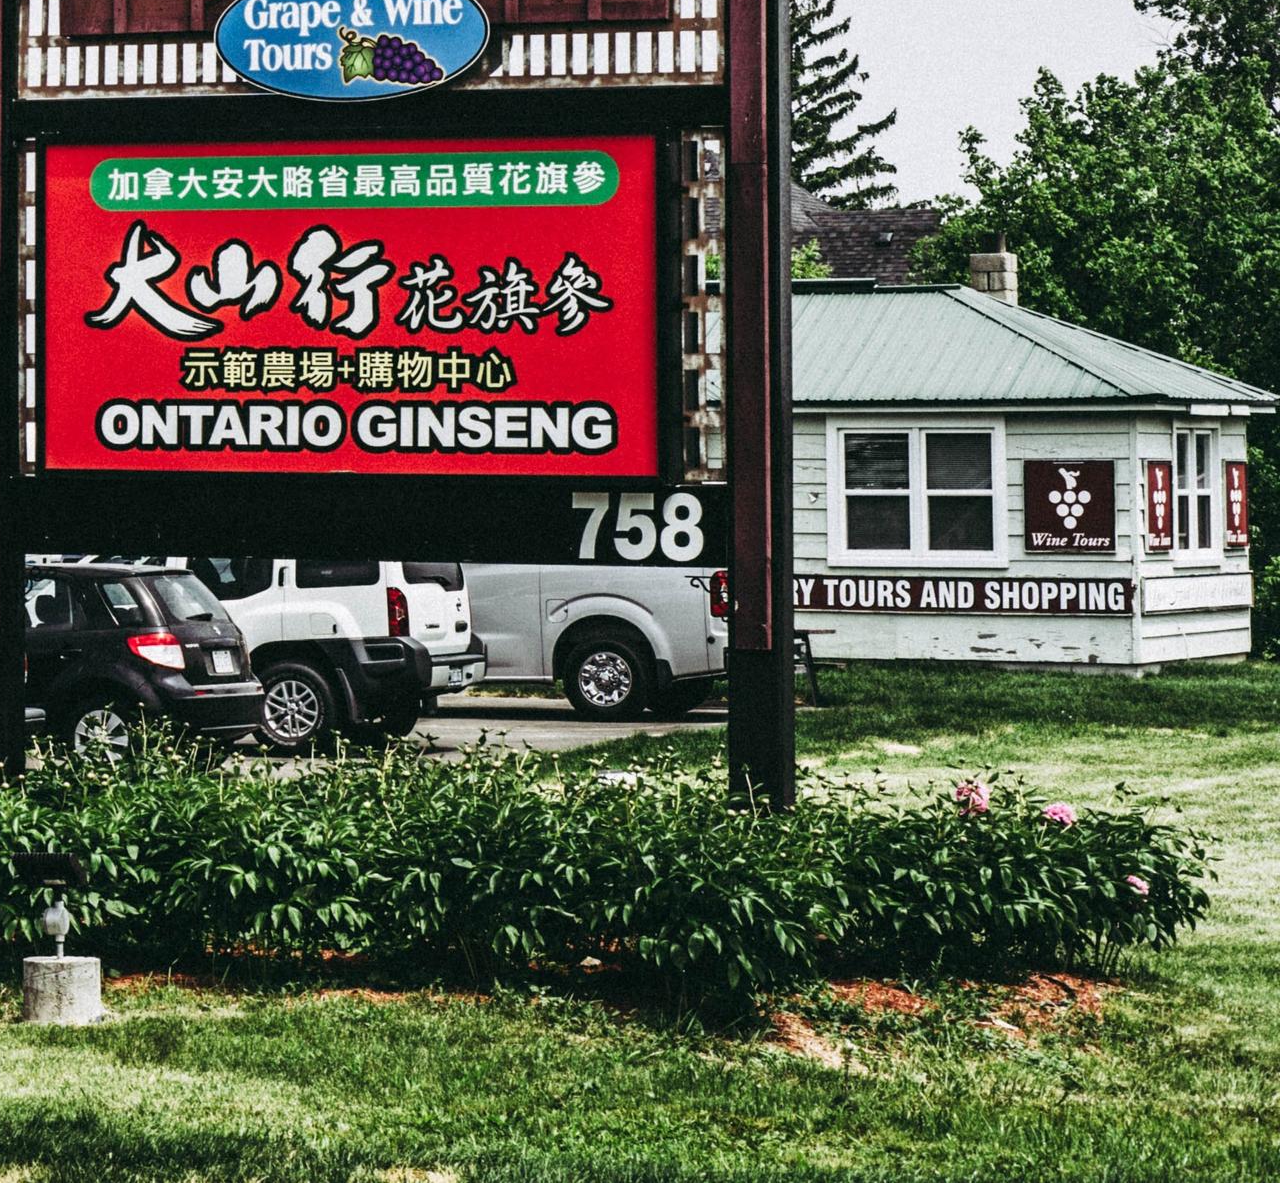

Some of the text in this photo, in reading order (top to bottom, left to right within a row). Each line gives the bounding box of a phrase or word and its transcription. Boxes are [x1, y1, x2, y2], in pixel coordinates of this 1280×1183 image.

[243, 39, 333, 74] Tours
[108, 160, 607, 202] 加拿大安大略省最高品質花旗參
[90, 219, 392, 337] 大山行
[100, 402, 614, 450] ONTARIO GINSENG
[572, 492, 704, 562] 758
[1031, 532, 1111, 547] Wine Tours
[823, 580, 911, 608] TOURS
[920, 581, 974, 609] AND
[984, 581, 1125, 611] SHOPPING
